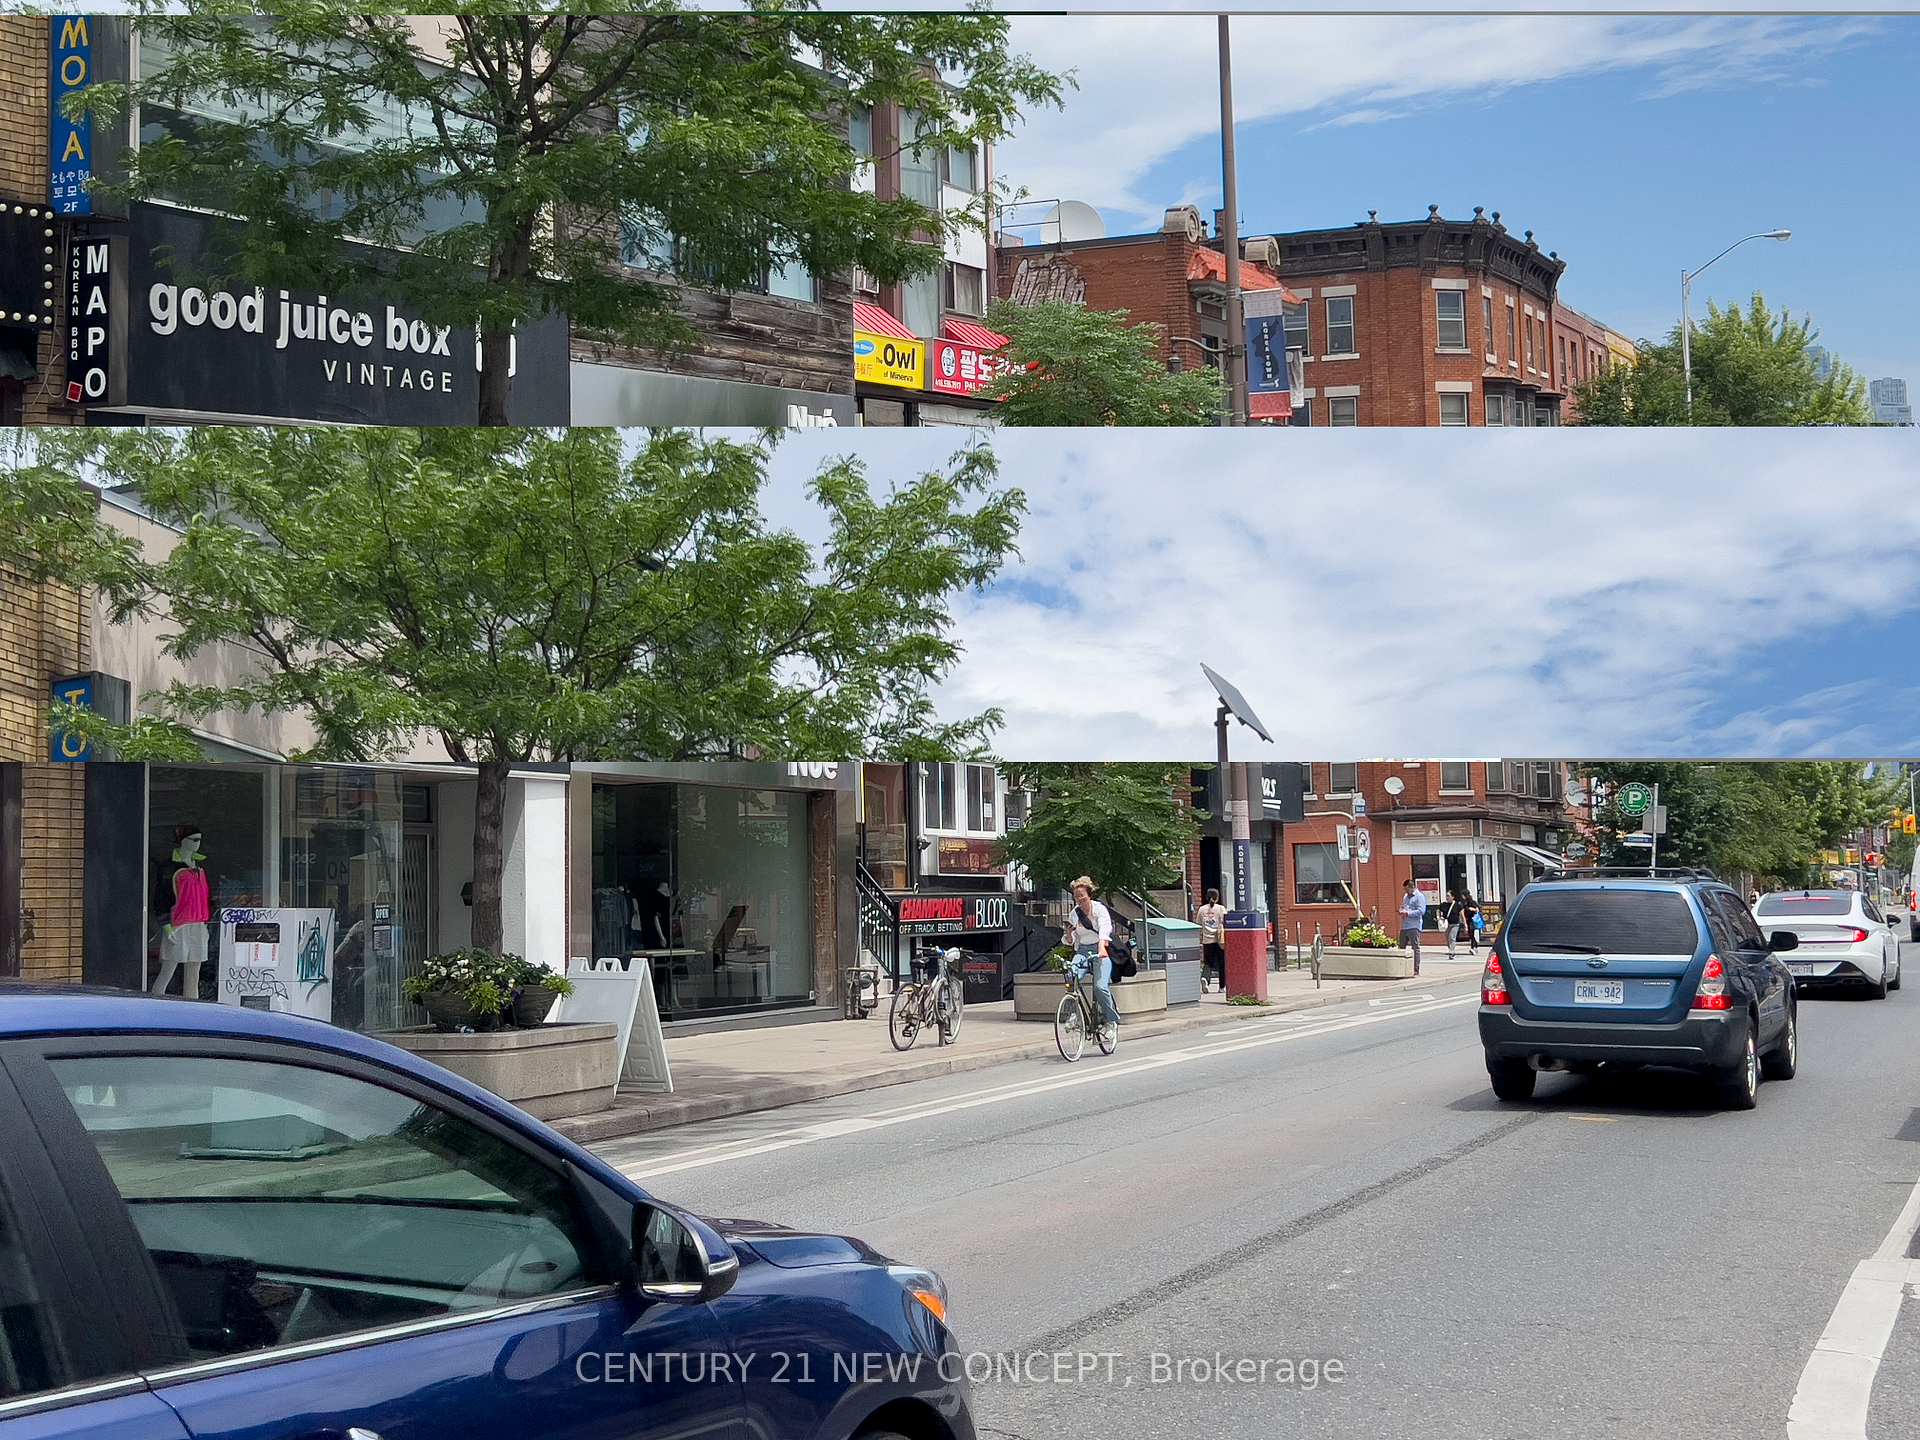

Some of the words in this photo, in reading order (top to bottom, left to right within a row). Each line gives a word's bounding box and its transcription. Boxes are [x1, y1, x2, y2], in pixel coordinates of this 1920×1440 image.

[59, 17, 89, 162] MOA
[63, 201, 79, 213] 2F
[71, 247, 80, 316] KOREAN
[85, 244, 108, 398] MAPO
[149, 282, 265, 336] good
[275, 290, 374, 349] juice
[386, 305, 452, 357] box
[883, 343, 915, 370] Owl
[322, 359, 453, 393] VINTAGE
[890, 371, 914, 383] Minerva
[1628, 791, 1643, 806] P
[900, 897, 963, 919] CHAMPIONS
[975, 898, 1008, 928] BLOOR
[899, 924, 912, 934] OFF
[915, 923, 935, 933] TRACK
[937, 922, 963, 932] BETTING
[1604, 986, 1621, 999] 942
